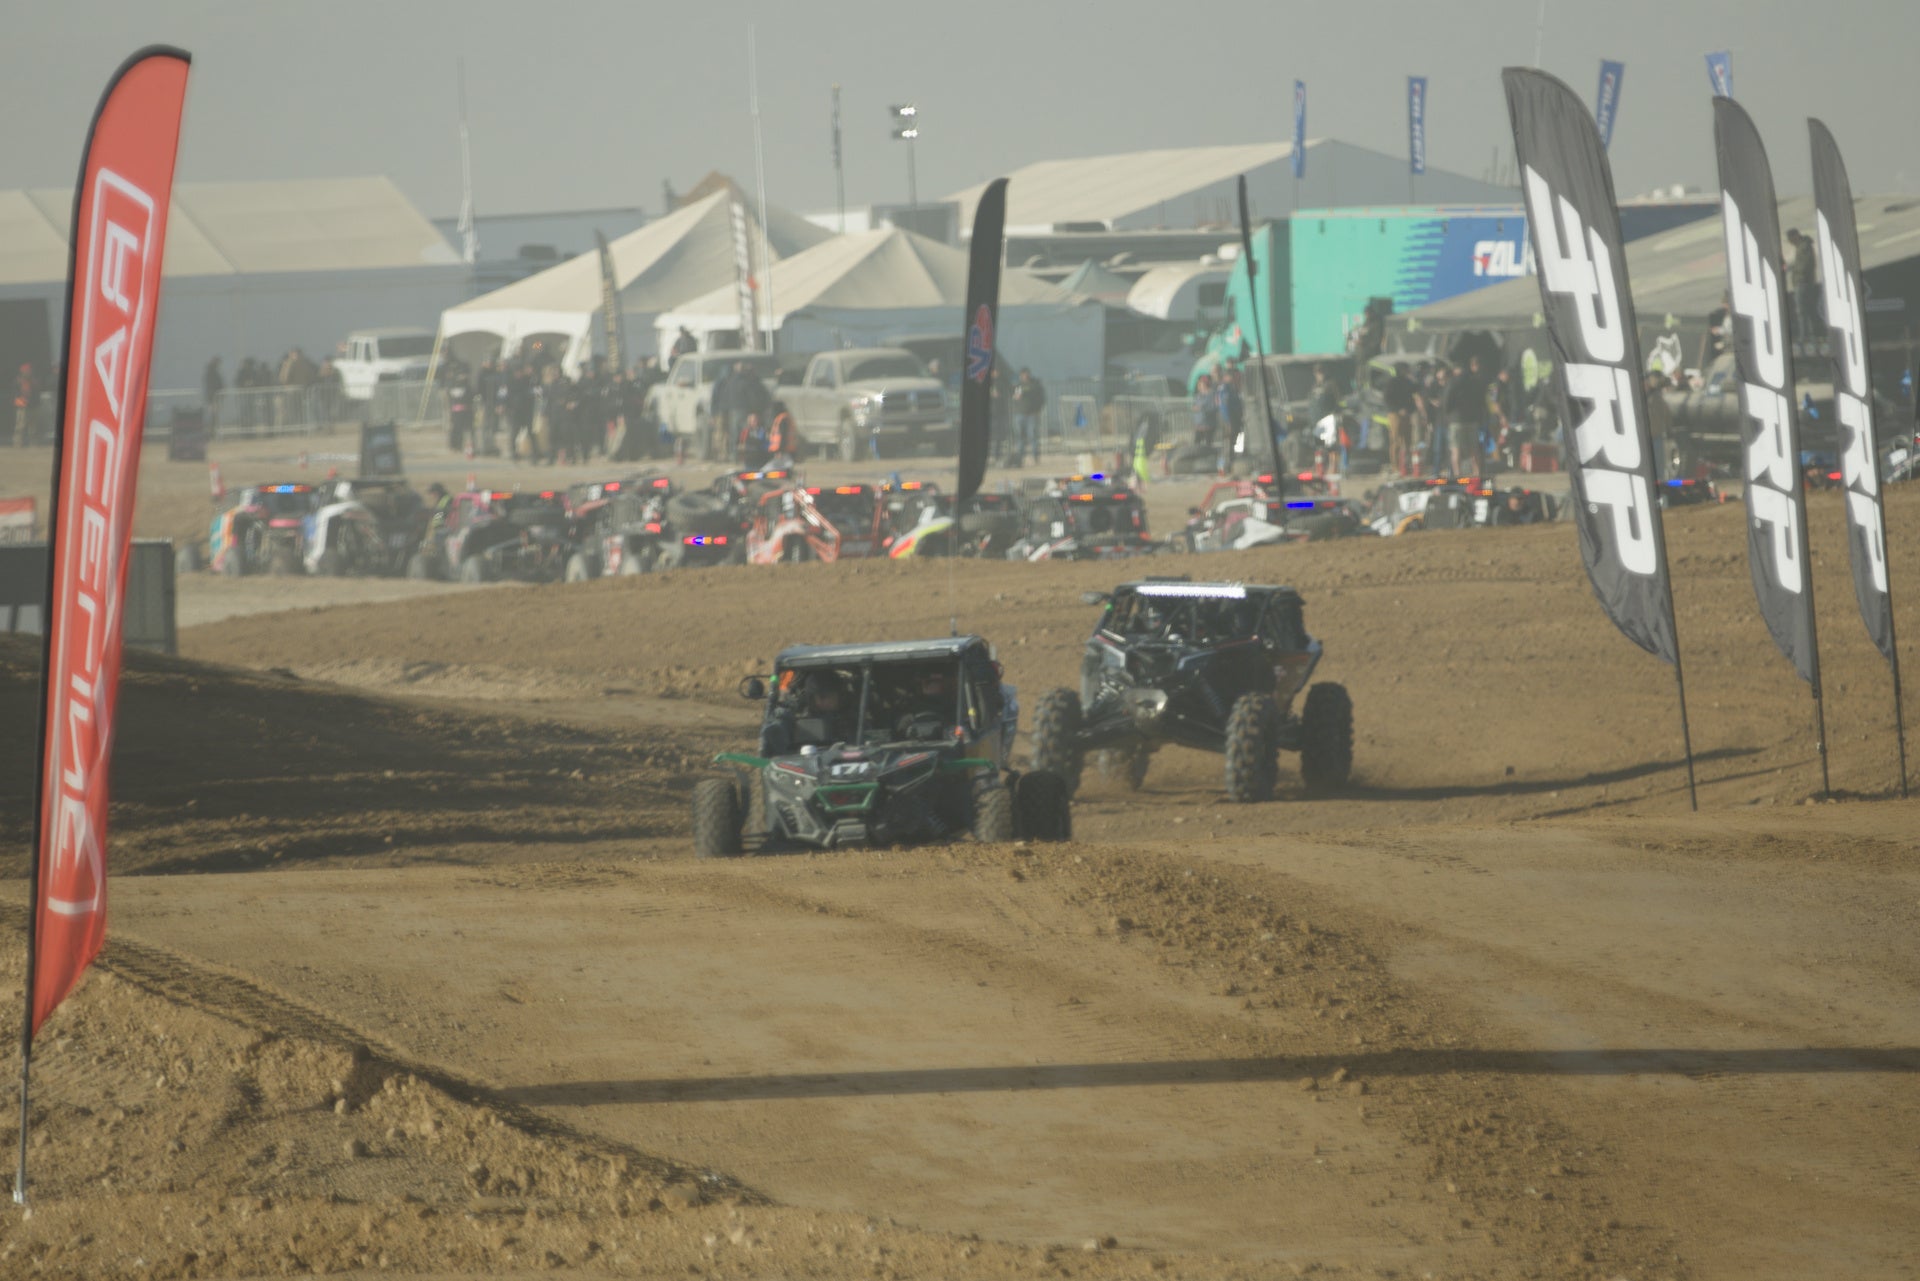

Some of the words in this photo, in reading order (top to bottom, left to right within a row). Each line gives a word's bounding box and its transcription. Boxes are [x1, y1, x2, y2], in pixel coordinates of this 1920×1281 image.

[1526, 164, 1656, 575] PRP
[1722, 189, 1801, 594] PRP
[1816, 207, 1887, 593] PRP
